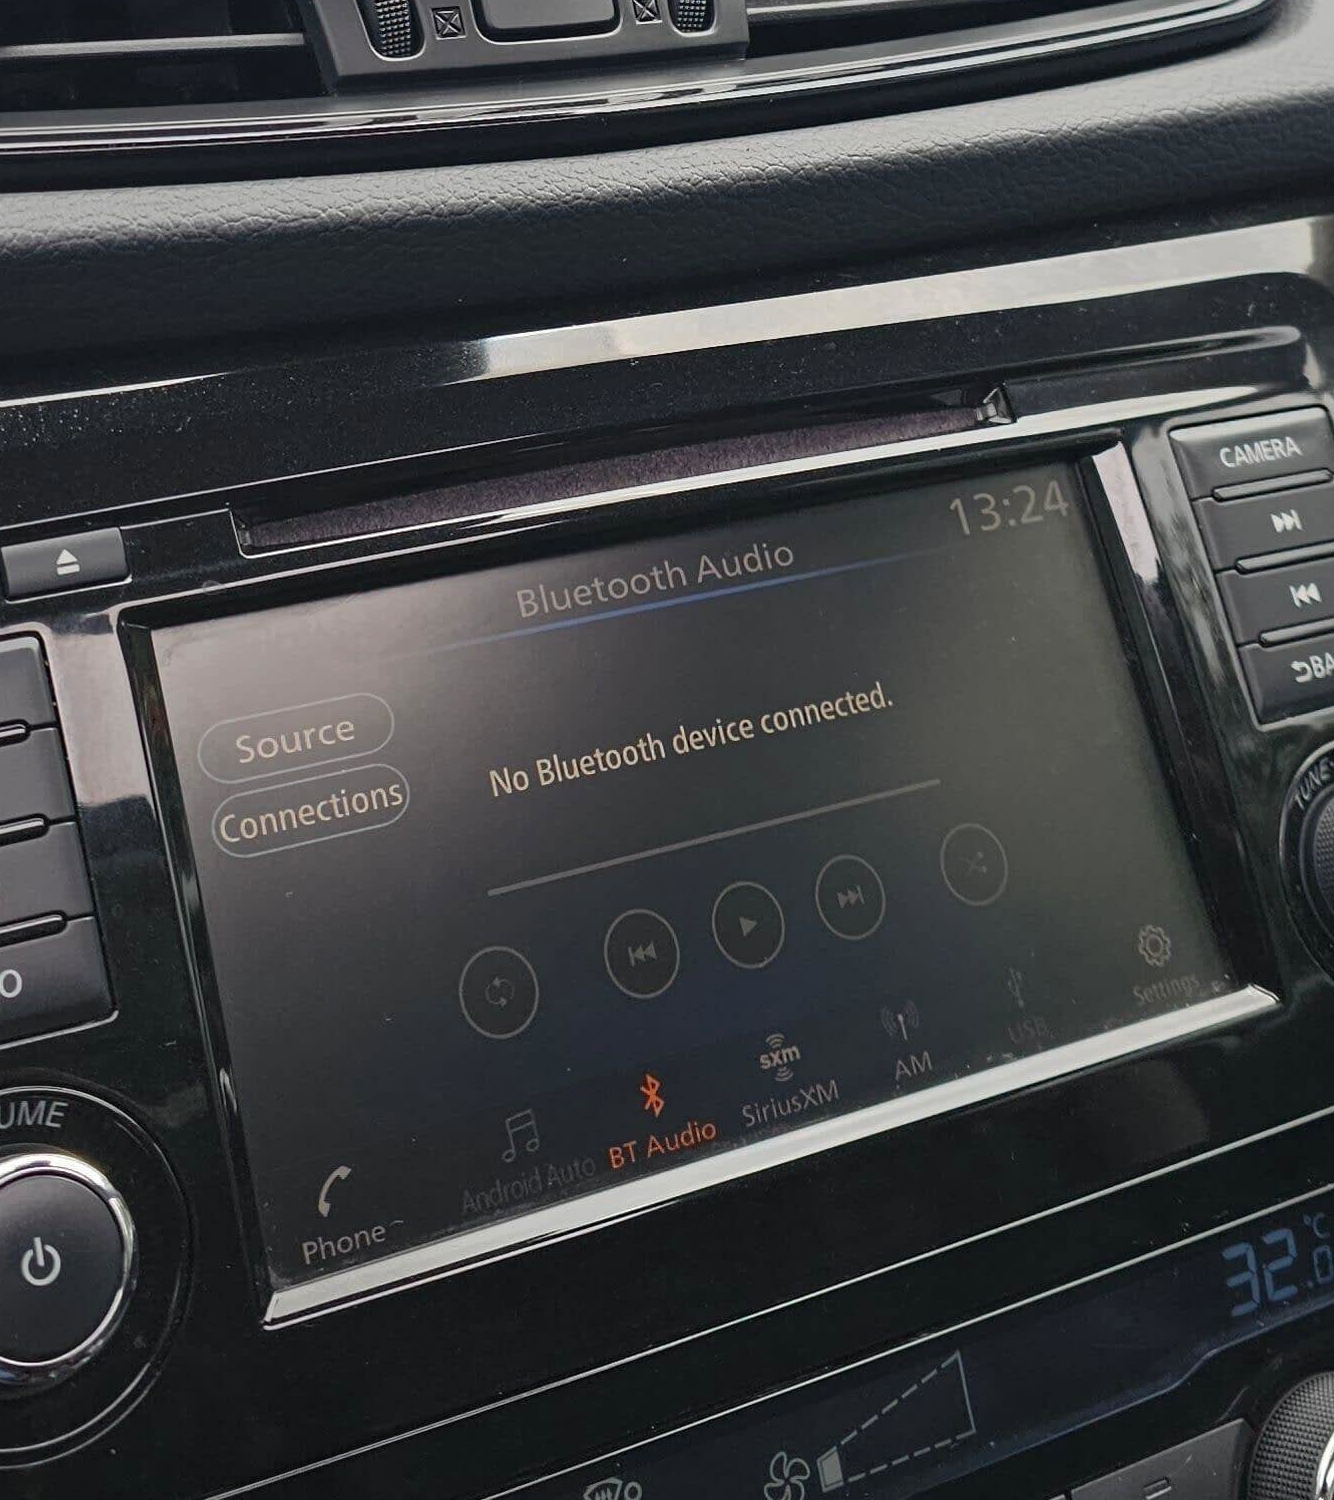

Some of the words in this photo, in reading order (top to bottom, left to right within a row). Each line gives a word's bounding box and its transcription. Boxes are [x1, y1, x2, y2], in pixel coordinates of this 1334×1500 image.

[1220, 436, 1303, 468] CAMERA
[948, 479, 1069, 537] 13:24
[517, 561, 688, 619] Bluetooth
[696, 539, 795, 583] Audio
[235, 718, 356, 764] Source
[489, 765, 530, 798] No
[536, 737, 666, 789] Bluetooth
[671, 713, 754, 754] device
[759, 682, 894, 735] connected.
[219, 782, 404, 844] Connections
[1008, 1015, 1052, 1044] USB
[894, 1049, 933, 1080] AM
[742, 1079, 841, 1127] SiriusXM
[609, 1140, 639, 1169] BT
[647, 1119, 717, 1157] Audio
[464, 1166, 541, 1212] Android
[543, 1155, 597, 1188] Auto
[301, 1223, 386, 1265] Phone
